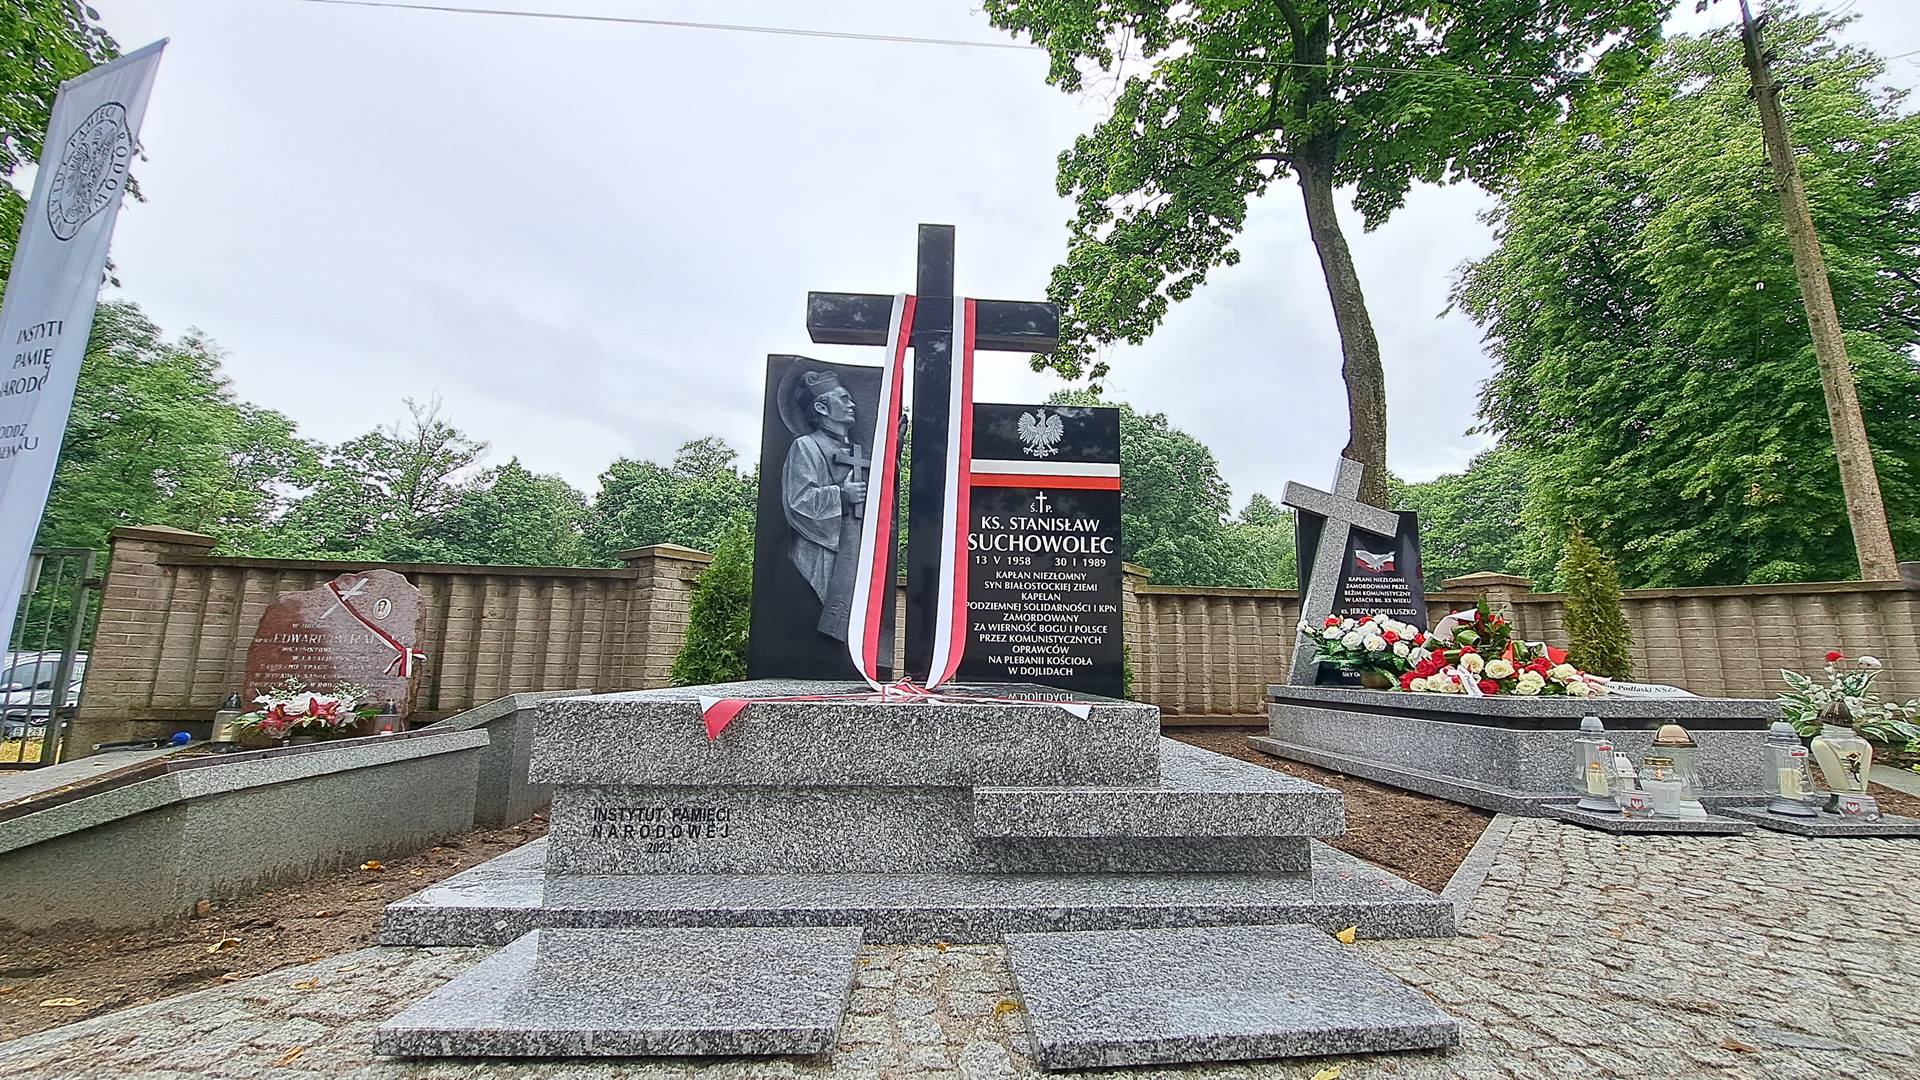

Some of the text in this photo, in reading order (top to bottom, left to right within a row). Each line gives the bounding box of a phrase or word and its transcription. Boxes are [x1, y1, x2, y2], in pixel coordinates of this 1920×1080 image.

[981, 516, 1100, 532] KS. STANISŁAW
[967, 533, 1114, 554] SUCHOWOLEC
[975, 555, 987, 565] 13
[993, 556, 1001, 565] V
[1007, 556, 1031, 566] 1958
[1054, 557, 1067, 567] 30
[1082, 558, 1107, 568] 1989
[996, 571, 1087, 581] KAPŁAN NIEZŁOMNY
[984, 581, 1098, 592] SYN BIAŁOSTOCKIEJ ZIEMI
[1021, 592, 1061, 601] KAPELAN
[1024, 602, 1091, 612] SOLIDARNOŚCI
[1099, 604, 1117, 613] KPN
[1371, 608, 1417, 616] POPIEŁUSZKO
[1003, 613, 1079, 622] ZAMORDOWANY
[974, 623, 986, 631] ZA
[988, 622, 1037, 632] WIERNOŚĆ
[1039, 625, 1067, 633] BOGU
[1075, 625, 1108, 634] POLSCE
[979, 634, 1101, 644] PRZEZ KOMUNISTYCZNYCH
[1012, 644, 1070, 654] OPRAWCÓW
[988, 655, 1093, 666] NA PLEBANII KOŚCIOŁA
[1008, 667, 1073, 676] W DOJLIDACH
[1618, 685, 1652, 693] Podlaski
[593, 808, 665, 822] INSTYTUT
[592, 824, 729, 839] NARODOWEJ
[648, 843, 672, 854] 2023
